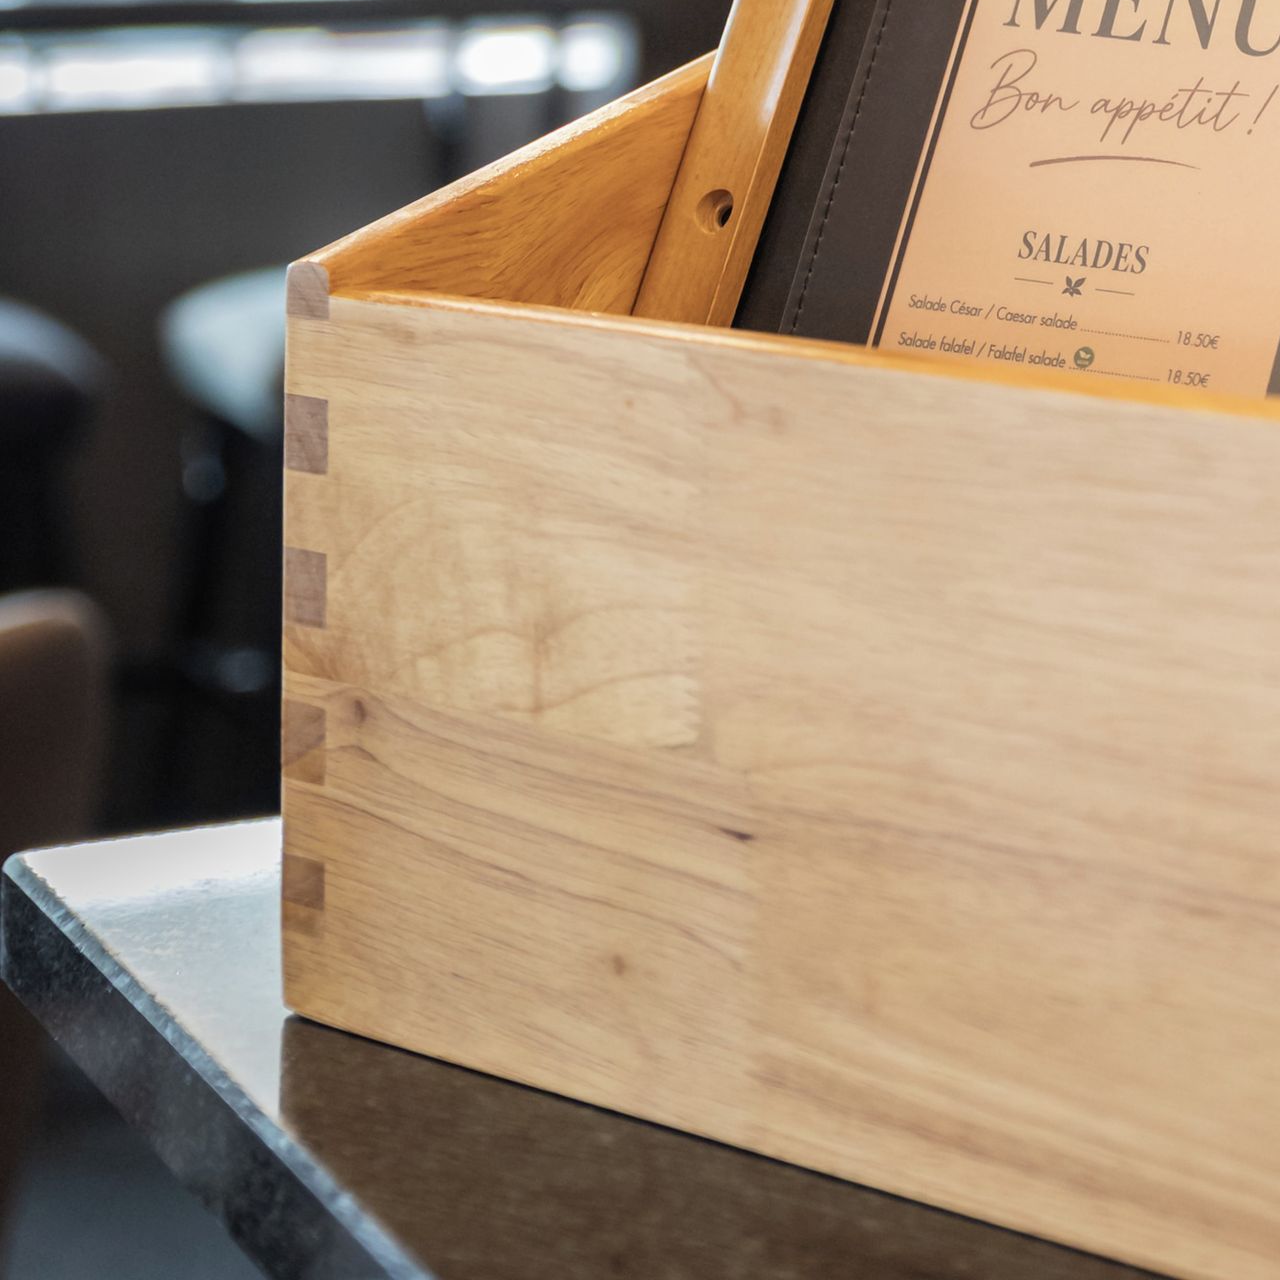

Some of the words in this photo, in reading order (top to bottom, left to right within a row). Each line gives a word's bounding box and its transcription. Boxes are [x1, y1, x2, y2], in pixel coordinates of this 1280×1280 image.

[970, 48, 1079, 130] Bon
[1090, 76, 1249, 145] appétit
[1247, 84, 1279, 136] !
[1017, 230, 1150, 275] SALADES
[908, 294, 947, 313] Salade
[950, 297, 982, 317] César
[984, 304, 995, 319] /
[996, 306, 1037, 326] Caesar
[1039, 312, 1078, 331] salade
[1177, 330, 1221, 350] 18.50€
[898, 331, 937, 351] Salade
[939, 335, 974, 355] falafel
[976, 342, 987, 358] /
[987, 343, 1027, 365] Falafel
[1028, 349, 1066, 369] salade
[1167, 369, 1211, 389] 18.50€
